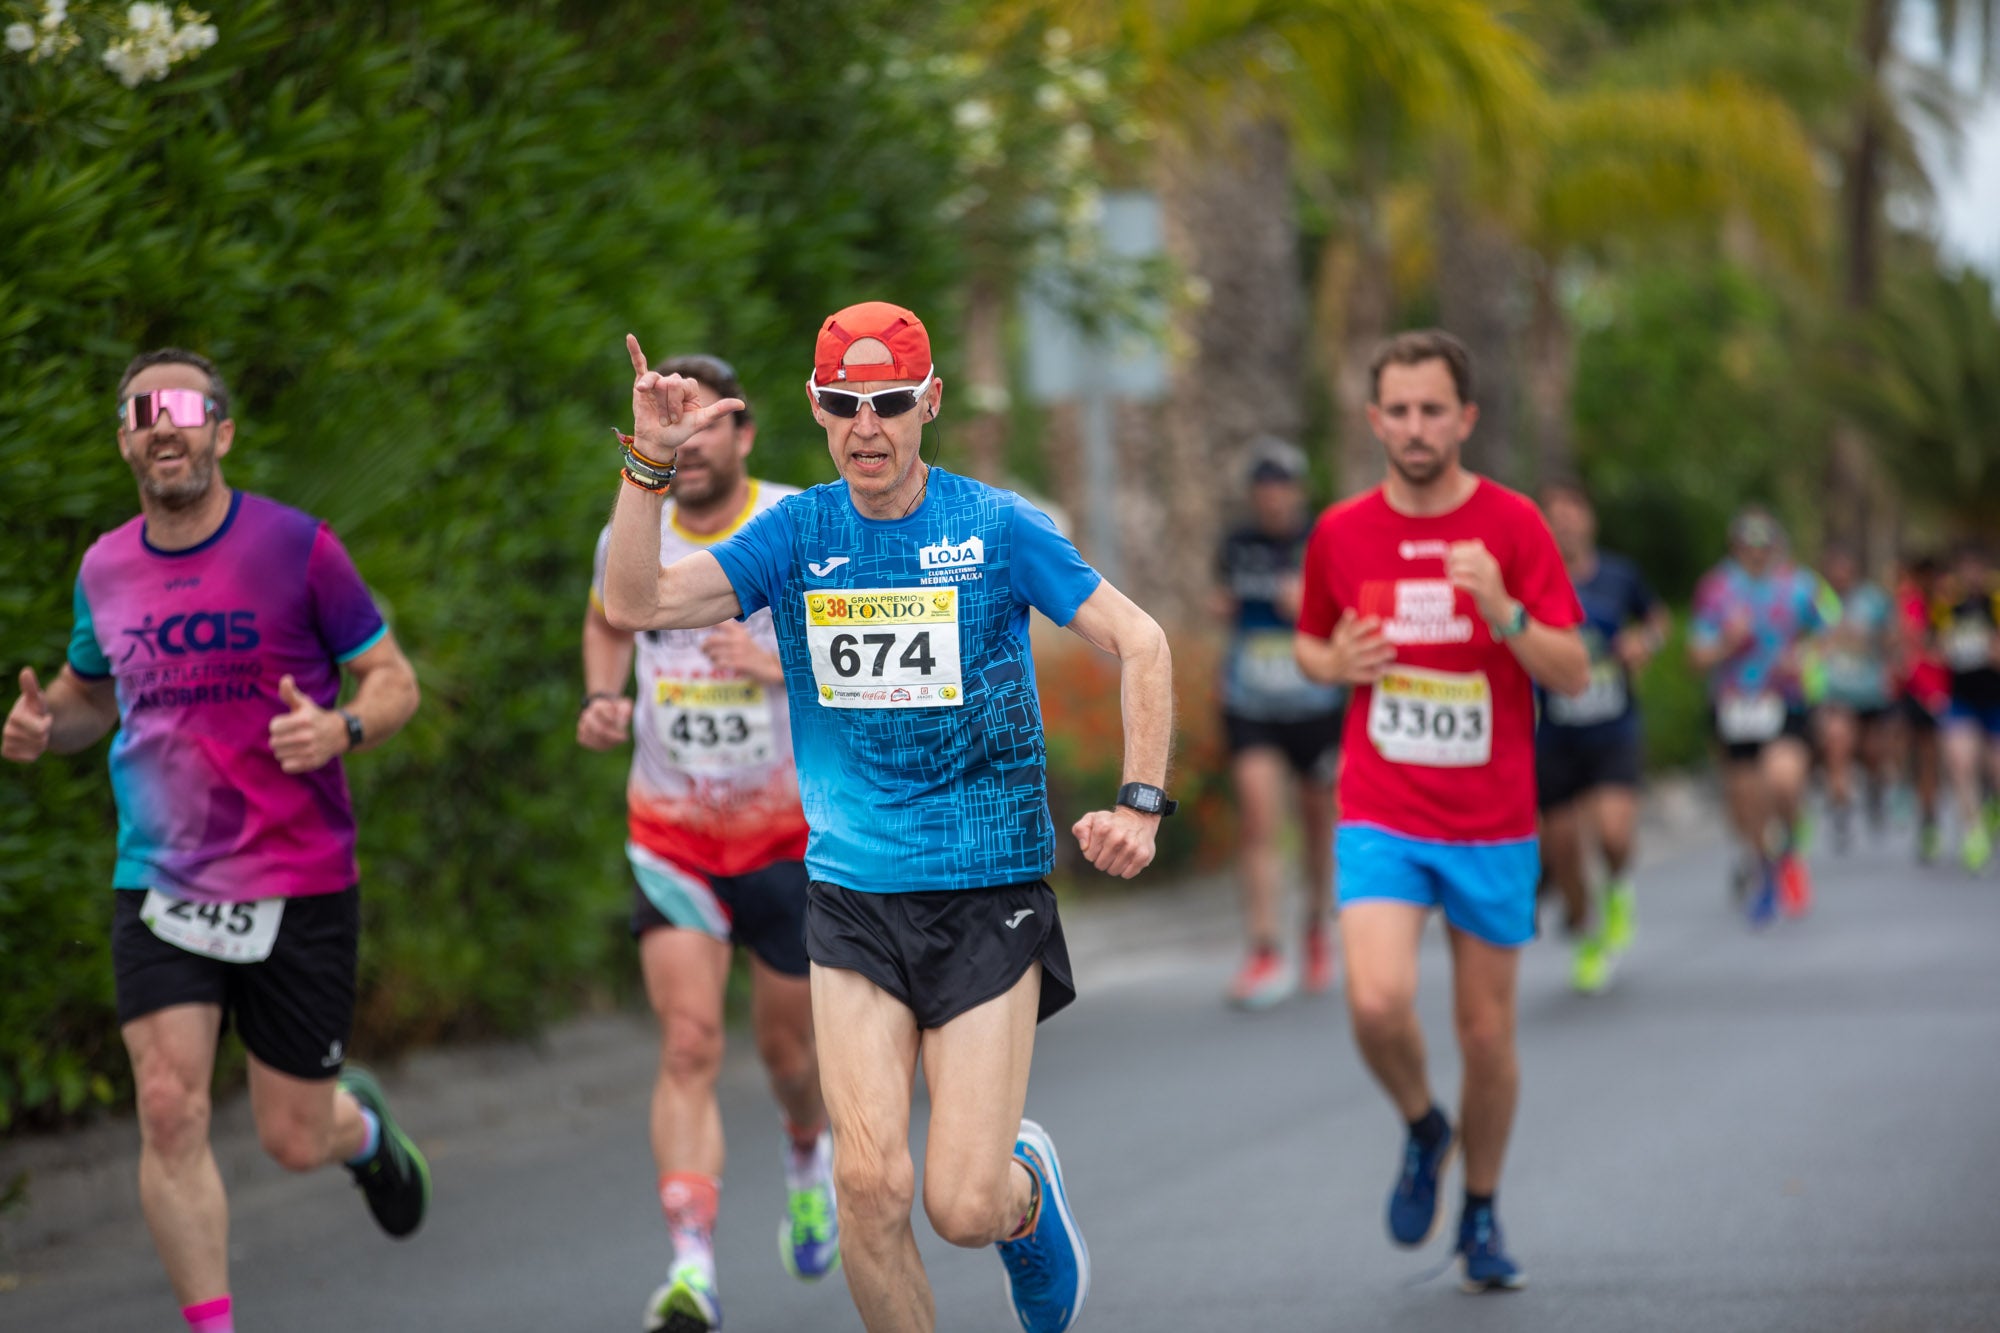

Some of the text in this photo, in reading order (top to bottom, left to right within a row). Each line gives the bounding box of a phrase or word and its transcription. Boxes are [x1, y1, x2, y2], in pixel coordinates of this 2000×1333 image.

[928, 548, 976, 565] LOJA
[920, 572, 983, 585] MEDINA LAUXA
[827, 598, 847, 618] 38
[850, 596, 877, 604] GRAN
[880, 595, 918, 603] PREMIO
[847, 602, 925, 619] FONDO
[158, 611, 260, 655] cas
[830, 631, 936, 678] 674
[671, 710, 748, 747] 433
[1378, 697, 1483, 740] 3303
[166, 901, 256, 936] 245
